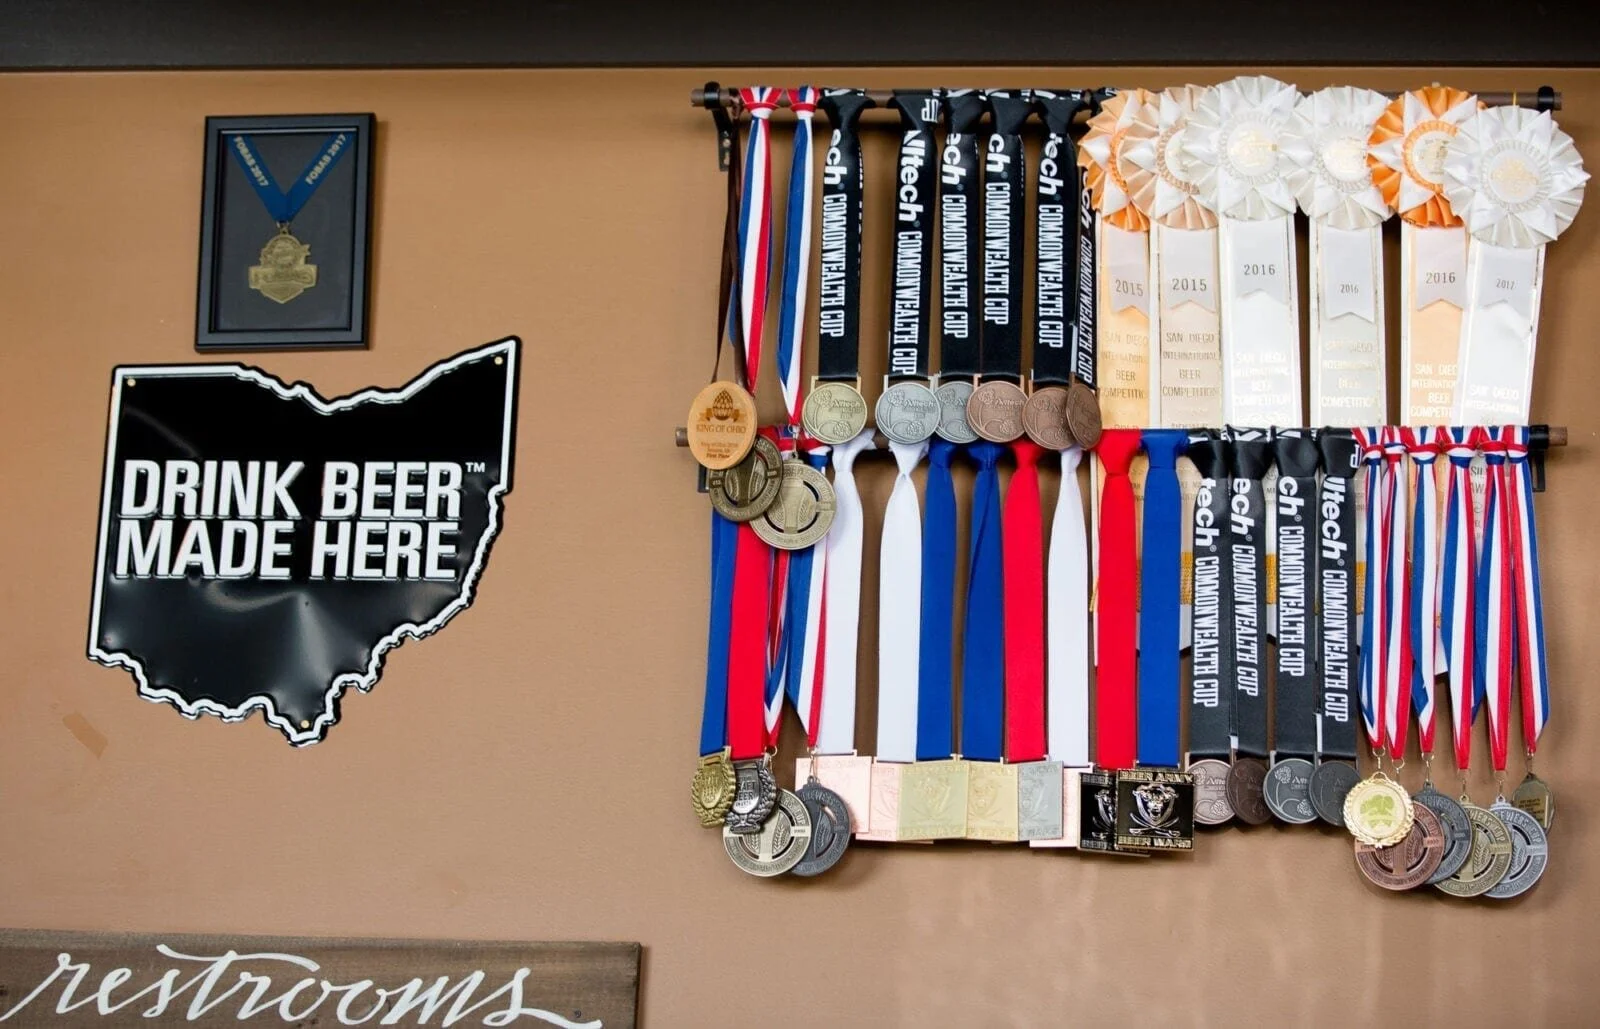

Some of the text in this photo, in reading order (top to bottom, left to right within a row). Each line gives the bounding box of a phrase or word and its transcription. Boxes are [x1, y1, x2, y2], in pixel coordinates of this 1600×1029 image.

[821, 193, 848, 306] COMMONWEALTH
[942, 194, 969, 307] COMMONWEALTH
[984, 182, 1011, 294] COMMONWEALTH
[1038, 204, 1064, 317] COMMONWEALTH
[1244, 264, 1276, 276] 2016
[894, 230, 923, 344] COMMONWEALTH
[1115, 279, 1144, 297] 2015
[1172, 278, 1208, 292] 2015
[1340, 283, 1359, 294] 2016
[1425, 271, 1456, 284] 2016
[1496, 278, 1515, 290] 2017
[1078, 235, 1094, 354] COMMONWEALTH
[819, 309, 845, 338] CUP
[943, 311, 969, 338] CUP
[983, 297, 1009, 325] CUP
[1038, 320, 1064, 348] CUP
[1166, 332, 1215, 343] SAN DIEGO
[892, 347, 918, 376] CUP
[1077, 354, 1093, 384] CUP
[1115, 369, 1136, 382] BEER
[1179, 368, 1201, 379] BEER
[1415, 363, 1433, 375] SAN
[1428, 391, 1450, 404] BEER
[696, 424, 746, 434] KING OF OHIO
[118, 460, 304, 519] DRINK
[320, 461, 463, 520] BEER
[115, 520, 463, 580] MADE HERE
[1279, 525, 1305, 644] COMMONWEALTH
[1193, 556, 1220, 676] COMMONWEALTH
[1232, 544, 1258, 666] COMMONWEALTH
[1322, 569, 1348, 690] COMMONWEALTH
[1279, 648, 1305, 677] CUP
[1192, 678, 1219, 708] CUP
[1236, 666, 1259, 697] CUP
[1324, 692, 1349, 722] CUP
[1119, 770, 1153, 782] BEER
[1118, 834, 1152, 847] BEER
[0, 944, 602, 1028] restrooms
